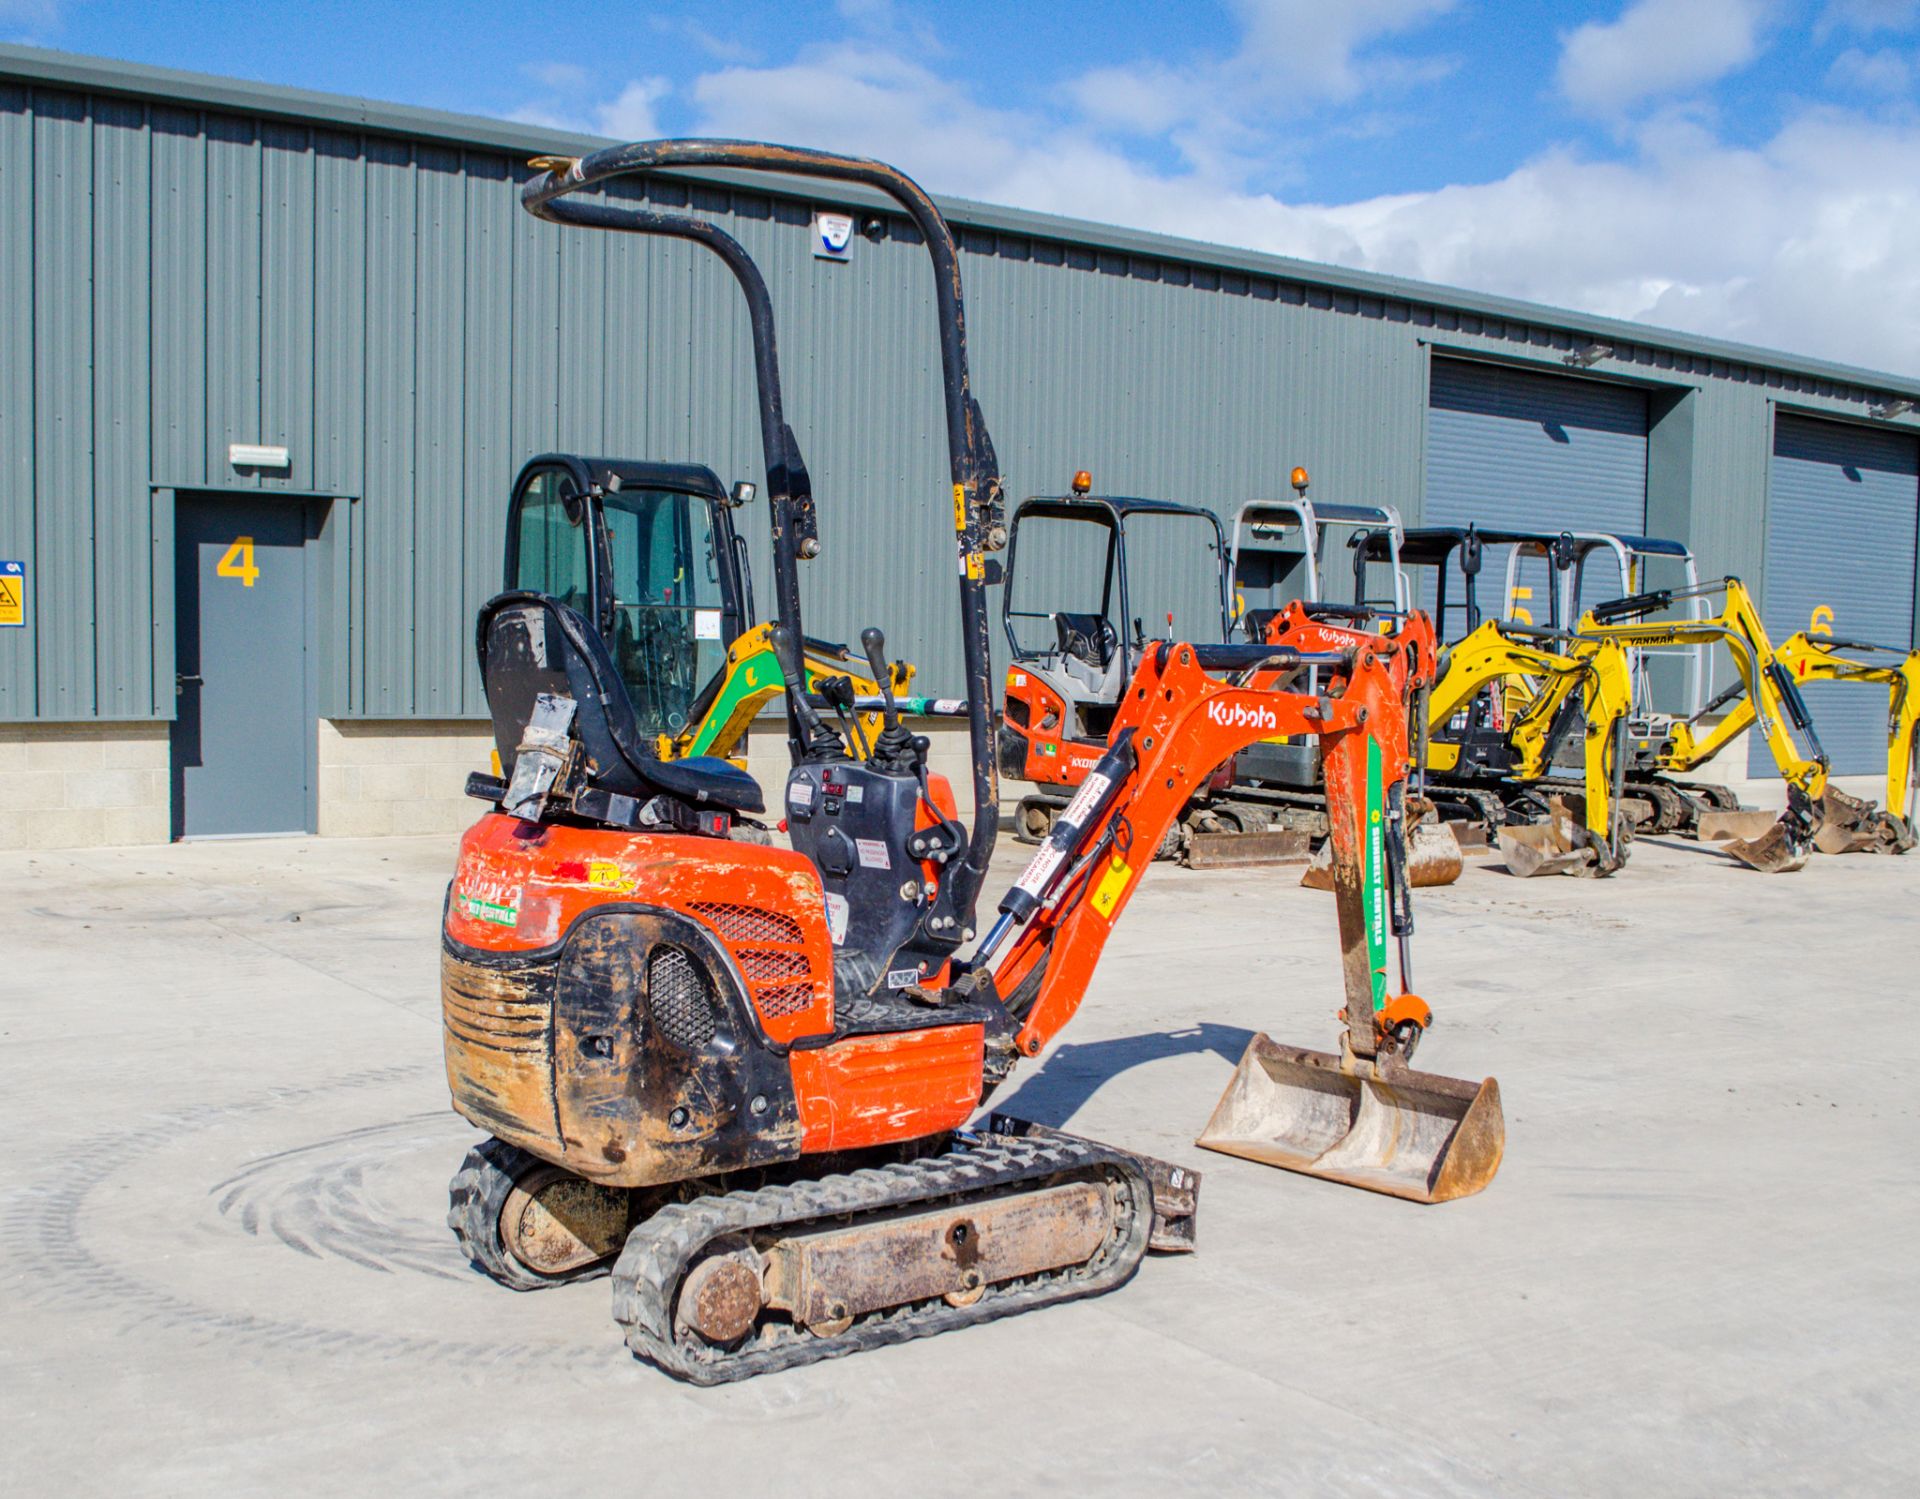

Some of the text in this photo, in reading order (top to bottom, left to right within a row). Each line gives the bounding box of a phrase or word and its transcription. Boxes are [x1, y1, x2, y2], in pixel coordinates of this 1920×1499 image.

[217, 535, 260, 587] 4
[1318, 627, 1357, 648] Kubota
[1629, 634, 1675, 646] YANMAR
[1810, 604, 1835, 653] 6
[1207, 700, 1277, 729] Kubota
[1372, 826, 1382, 946] SUNBELT RENTALS
